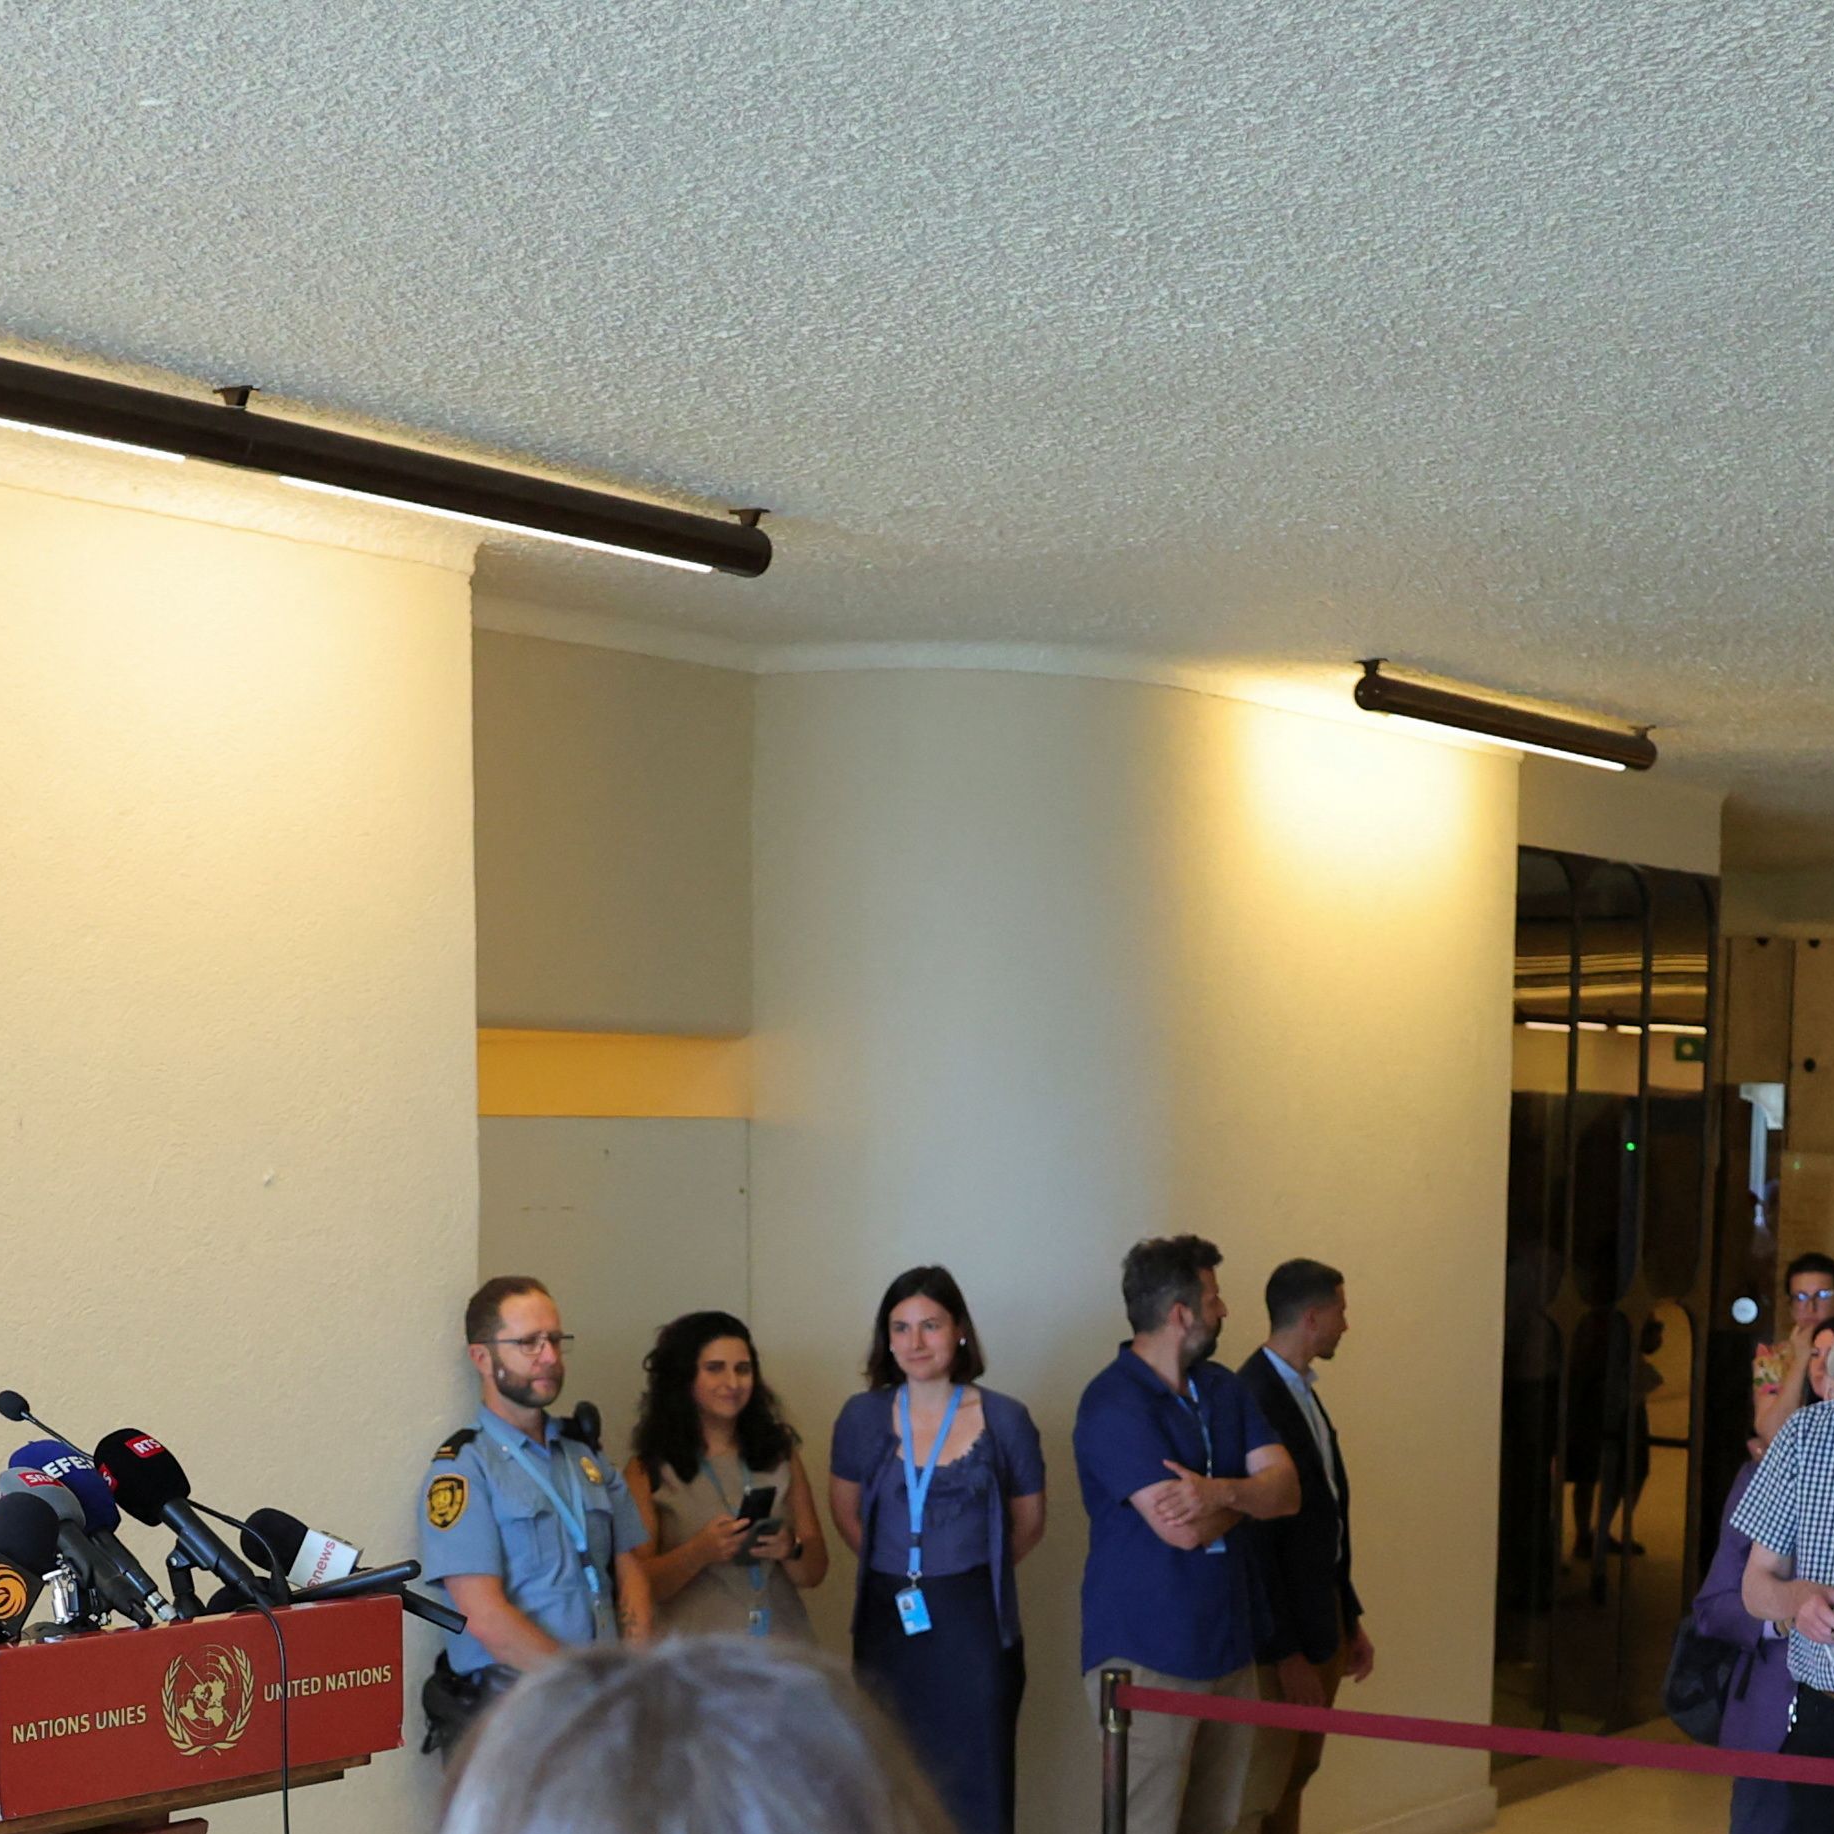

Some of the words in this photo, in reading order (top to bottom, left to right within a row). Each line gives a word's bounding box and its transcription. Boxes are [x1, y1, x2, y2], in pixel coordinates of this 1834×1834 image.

[132, 1438, 162, 1454] RTS
[264, 1676, 322, 1702] UNITED
[325, 1665, 392, 1693] NATIONS
[12, 1713, 91, 1744] NATIONS
[95, 1704, 147, 1730] UNIES
